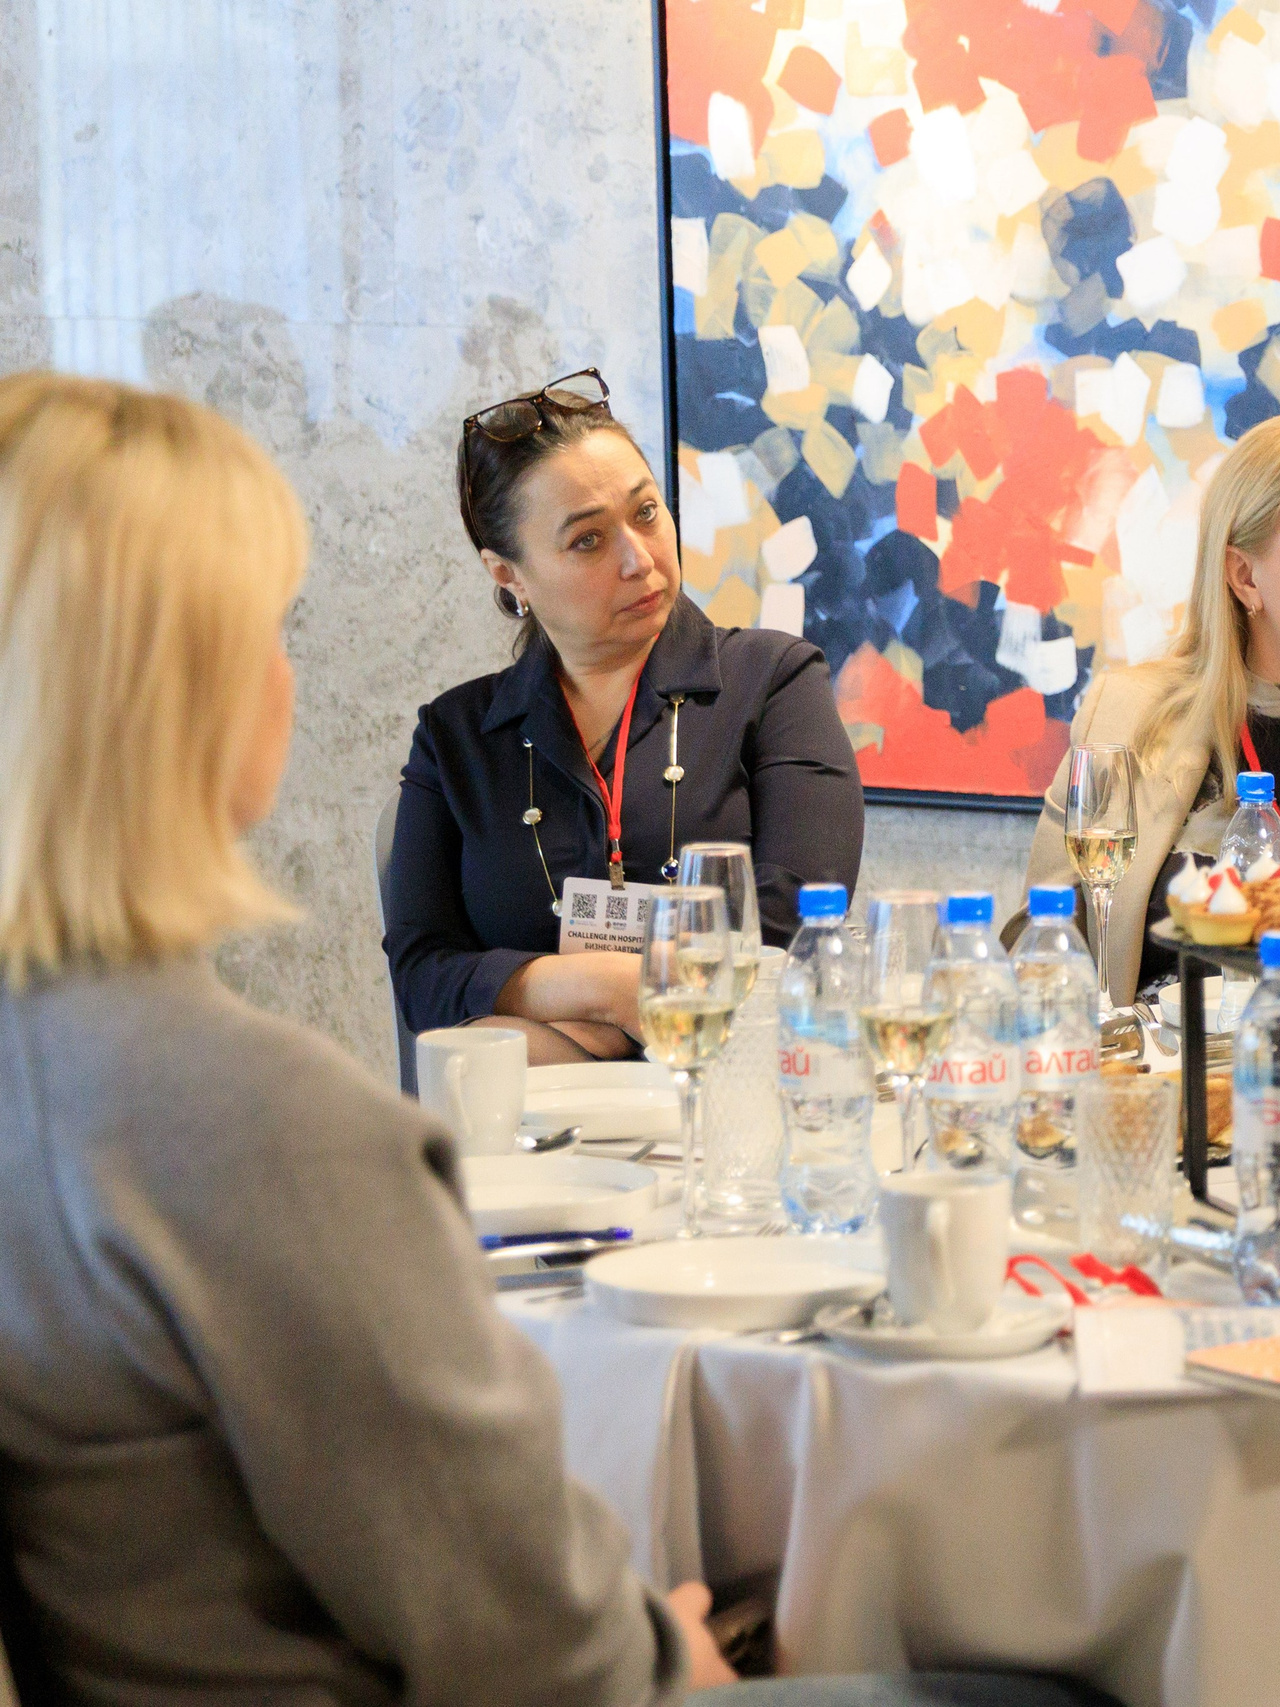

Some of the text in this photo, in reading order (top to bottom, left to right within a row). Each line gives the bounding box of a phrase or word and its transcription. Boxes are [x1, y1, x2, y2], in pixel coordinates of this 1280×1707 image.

[567, 930, 645, 943] CHALLENGE IN HOSPIT
